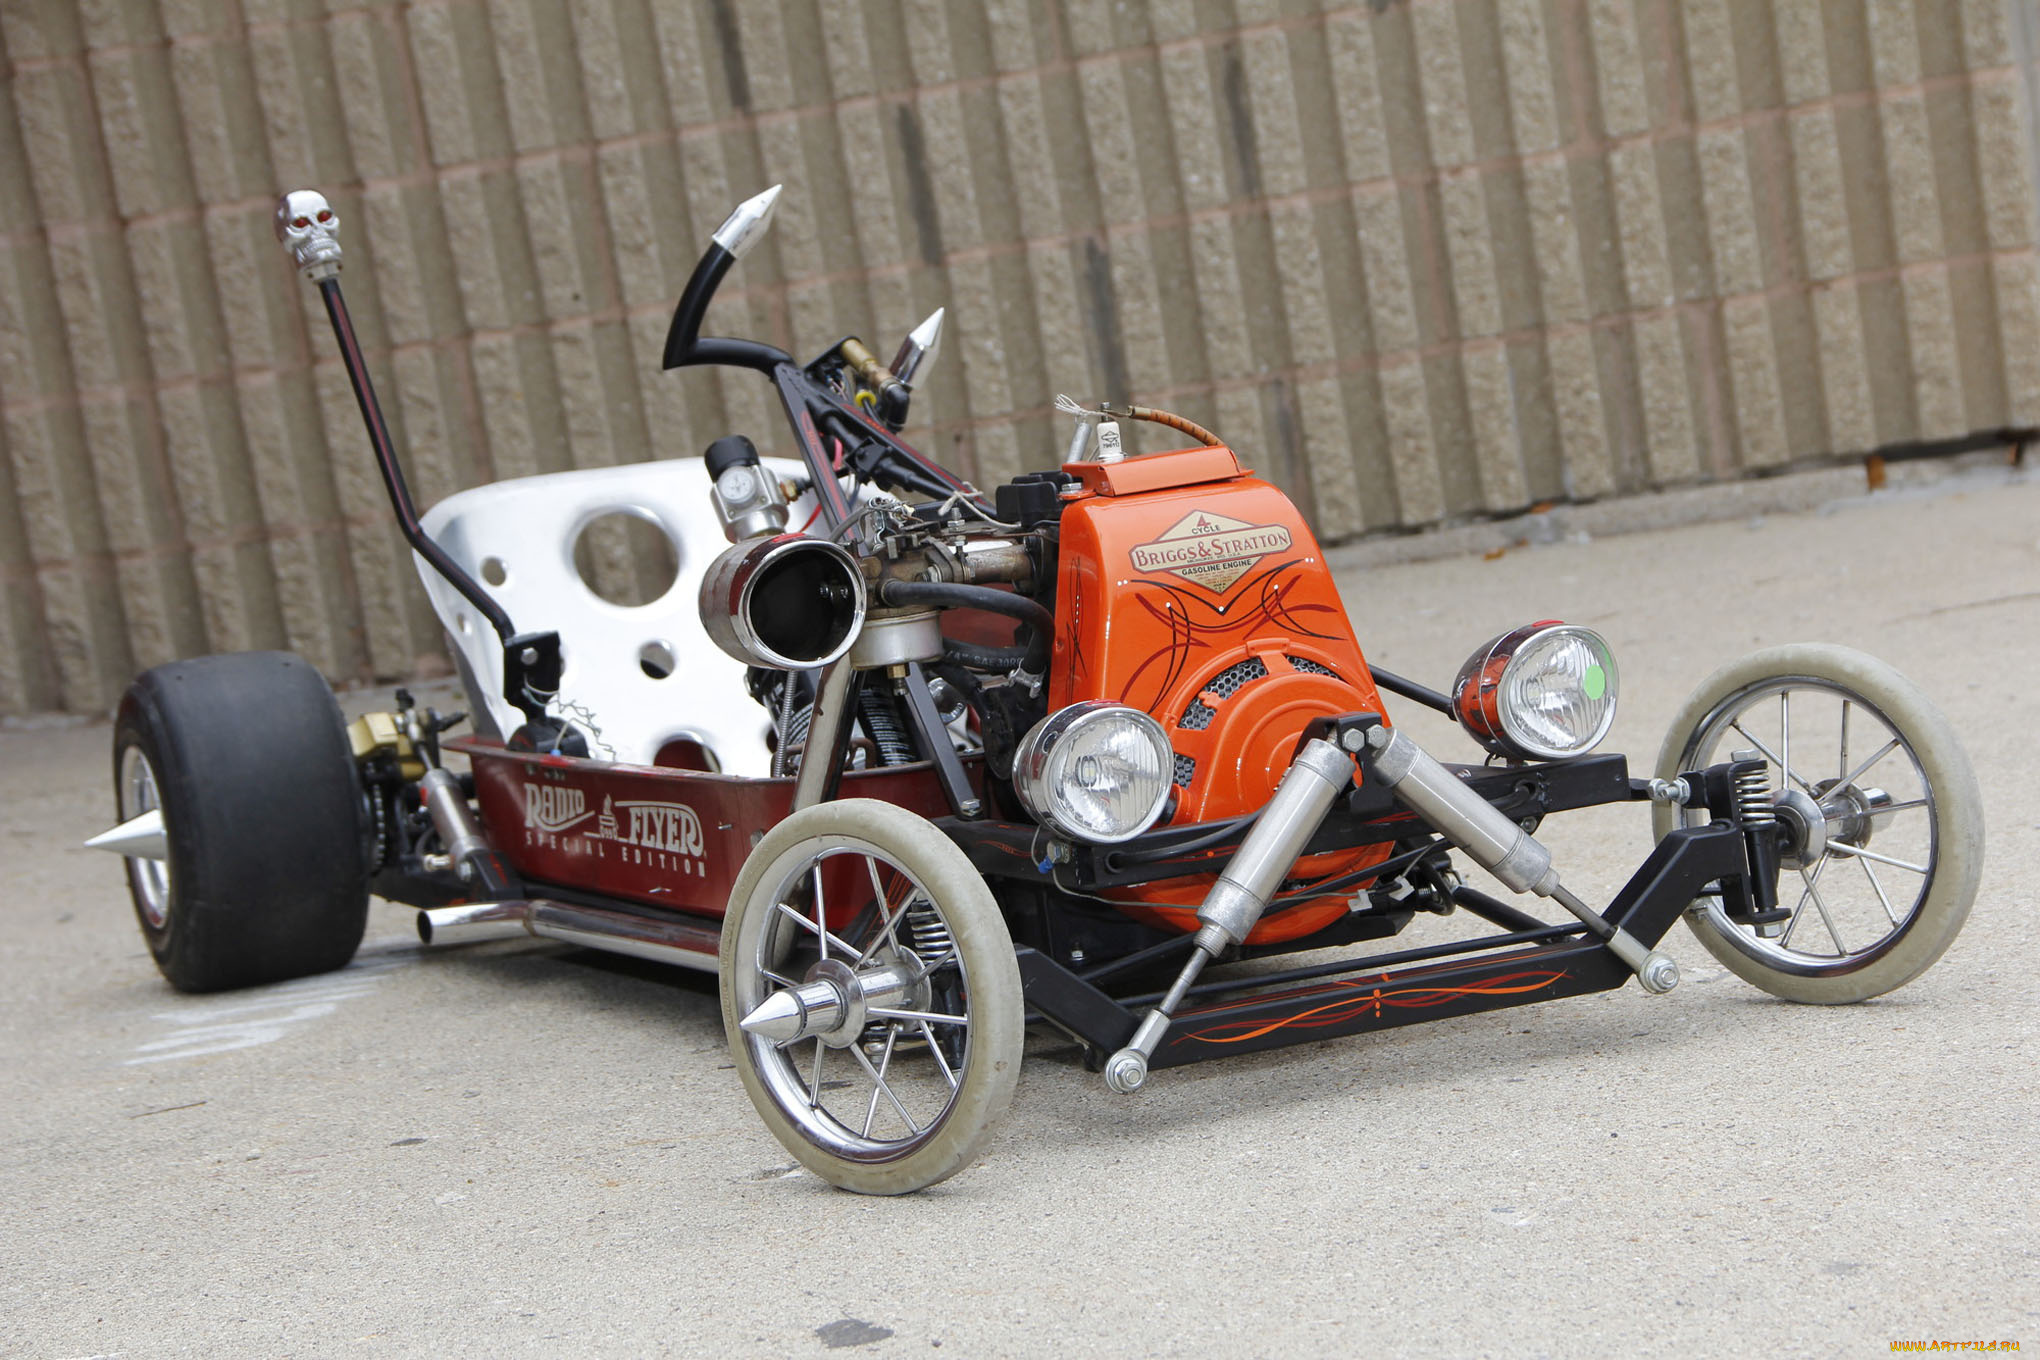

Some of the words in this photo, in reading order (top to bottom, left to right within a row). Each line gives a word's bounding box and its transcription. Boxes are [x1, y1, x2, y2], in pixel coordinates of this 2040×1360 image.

[1191, 524, 1221, 535] CYCLE
[1181, 564, 1221, 576] GASOLINE
[1222, 558, 1252, 570] ENGINE
[523, 783, 594, 832] RADIO
[617, 801, 704, 857] FLYER
[526, 831, 605, 858] SPECIAL
[621, 846, 706, 878] EDITION
